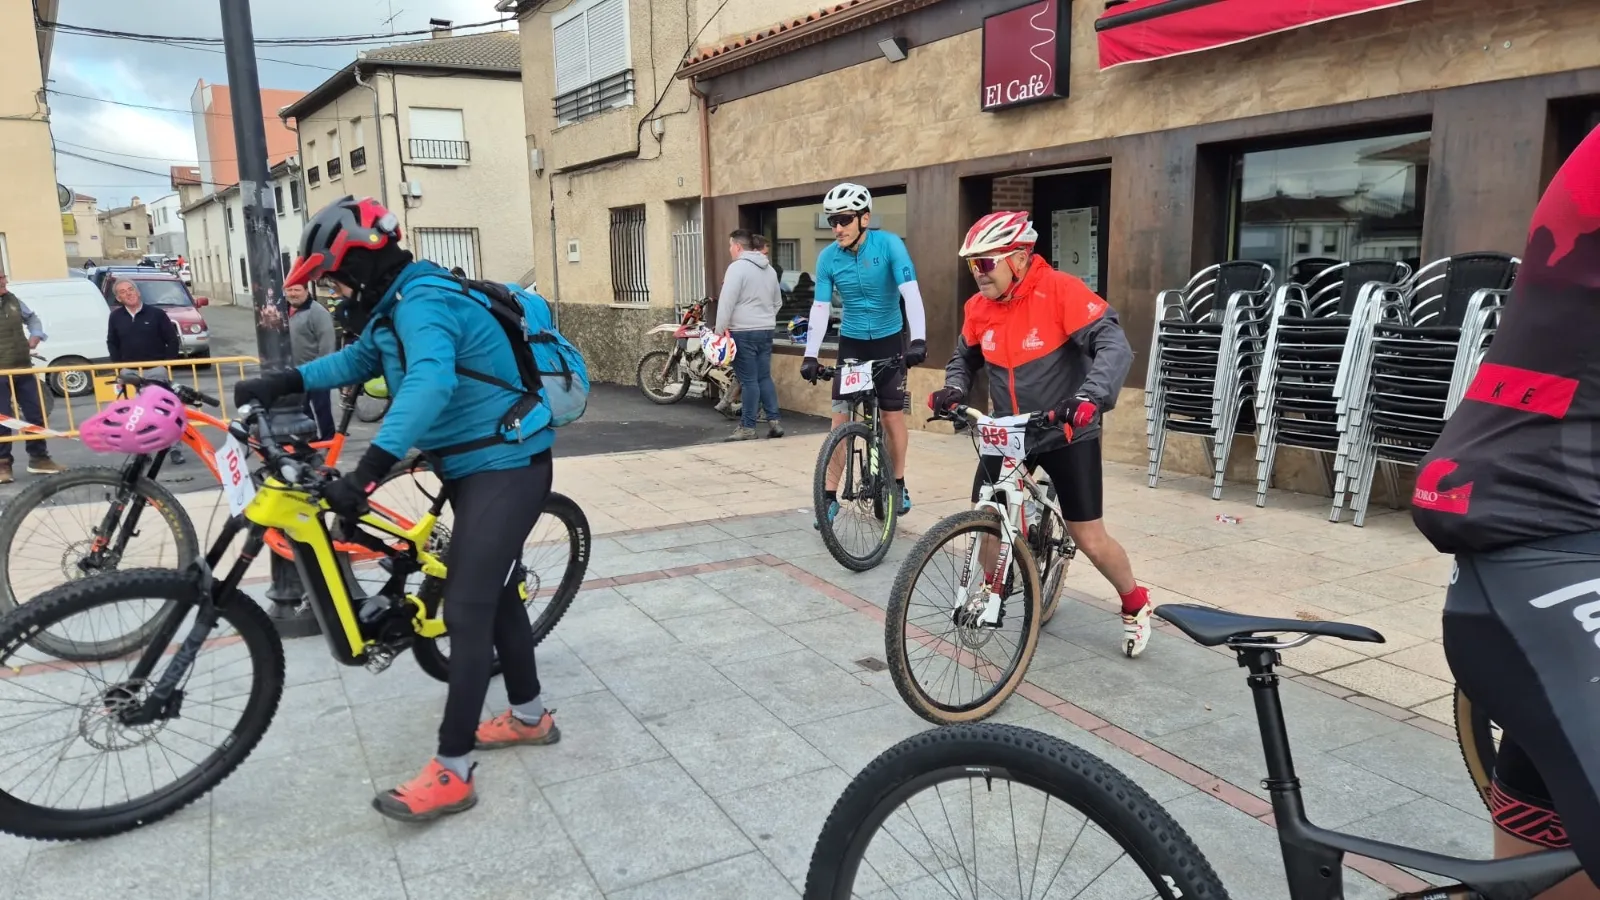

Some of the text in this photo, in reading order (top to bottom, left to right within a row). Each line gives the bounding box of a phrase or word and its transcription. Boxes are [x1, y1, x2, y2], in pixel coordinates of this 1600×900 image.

[985, 74, 1044, 107] El Café
[845, 372, 860, 386] 061
[125, 405, 144, 432] POC
[982, 426, 1008, 446] 059
[226, 449, 242, 486] 108
[575, 527, 586, 562] MAXXIS
